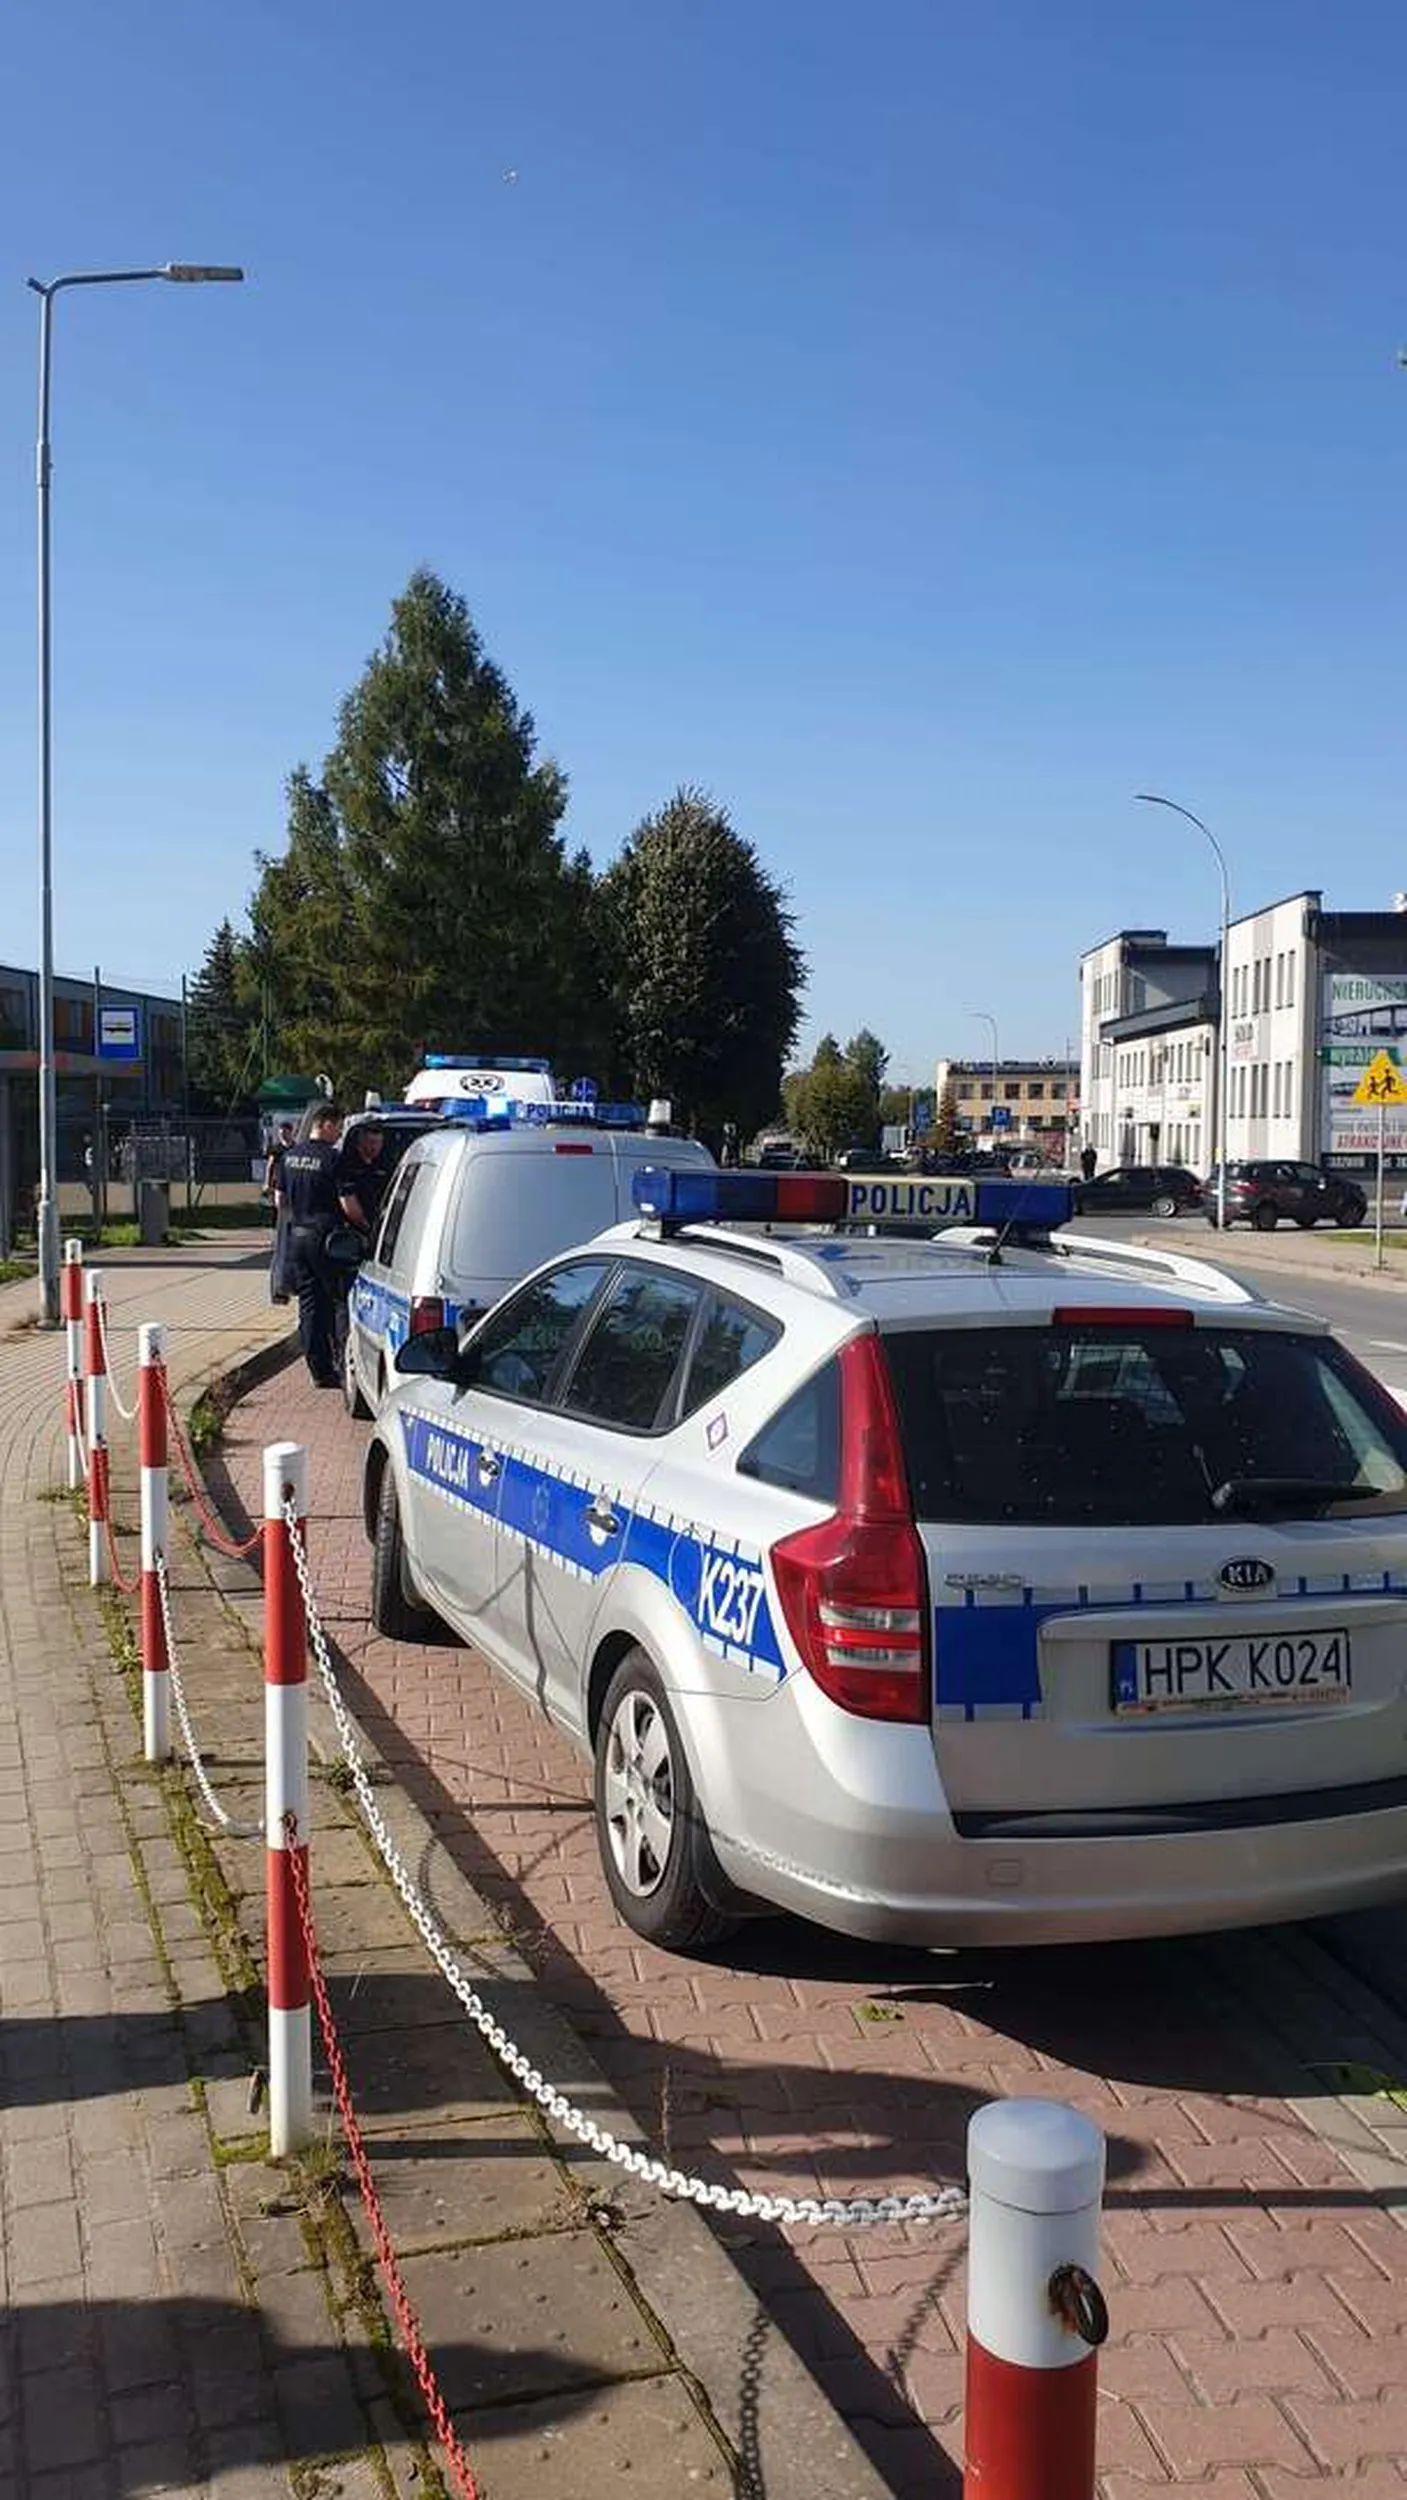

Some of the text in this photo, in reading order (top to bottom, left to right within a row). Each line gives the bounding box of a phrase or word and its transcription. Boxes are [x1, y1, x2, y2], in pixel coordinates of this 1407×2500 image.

[526, 1102, 594, 1118] POLICJA
[284, 1155, 321, 1170] POLICJA
[851, 1184, 970, 1216] POLICJA
[426, 1432, 469, 1491] POLICJA
[1229, 1564, 1269, 1584] KIA
[698, 1552, 766, 1645] K237
[1145, 1637, 1342, 1695] HPK K024
